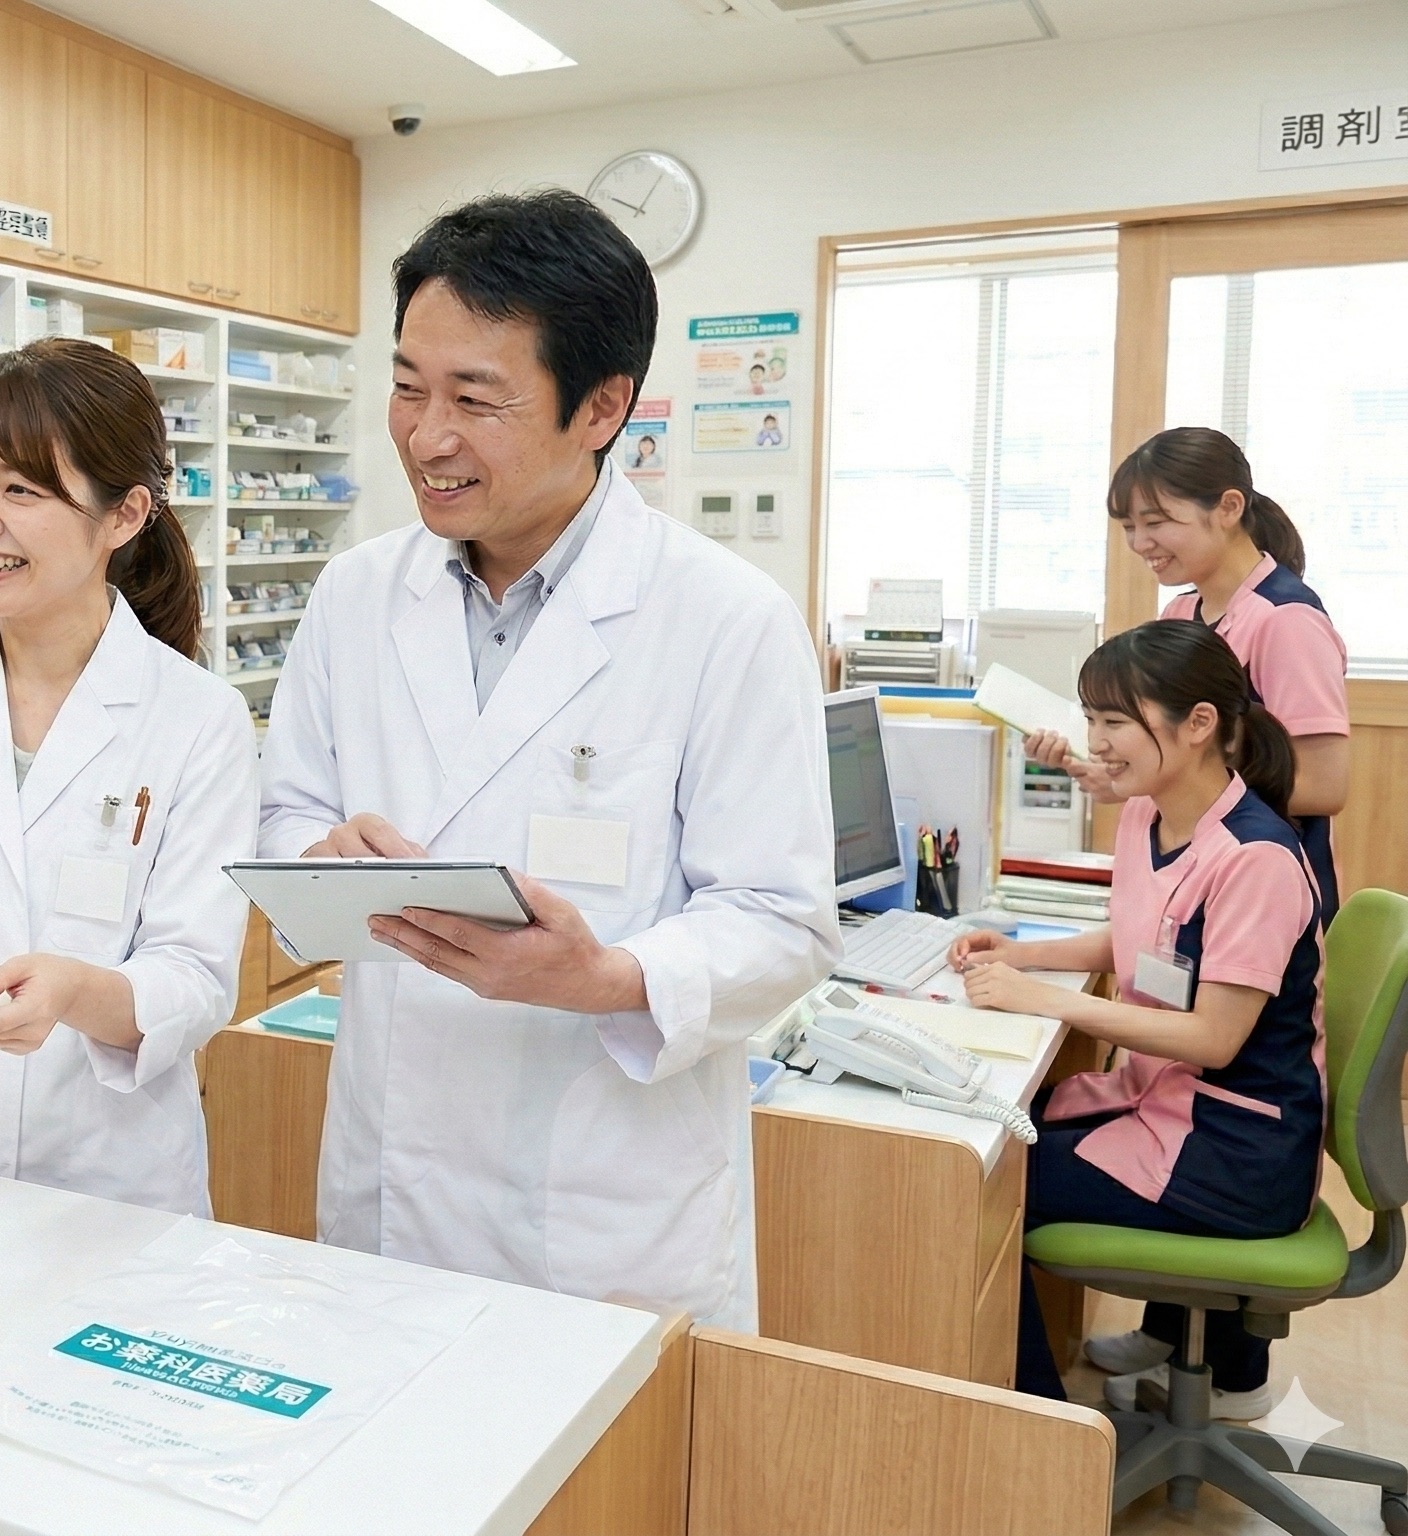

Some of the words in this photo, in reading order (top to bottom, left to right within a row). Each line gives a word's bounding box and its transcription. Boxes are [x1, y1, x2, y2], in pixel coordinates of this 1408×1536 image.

[80, 1333, 313, 1407] お薬科医薬局
